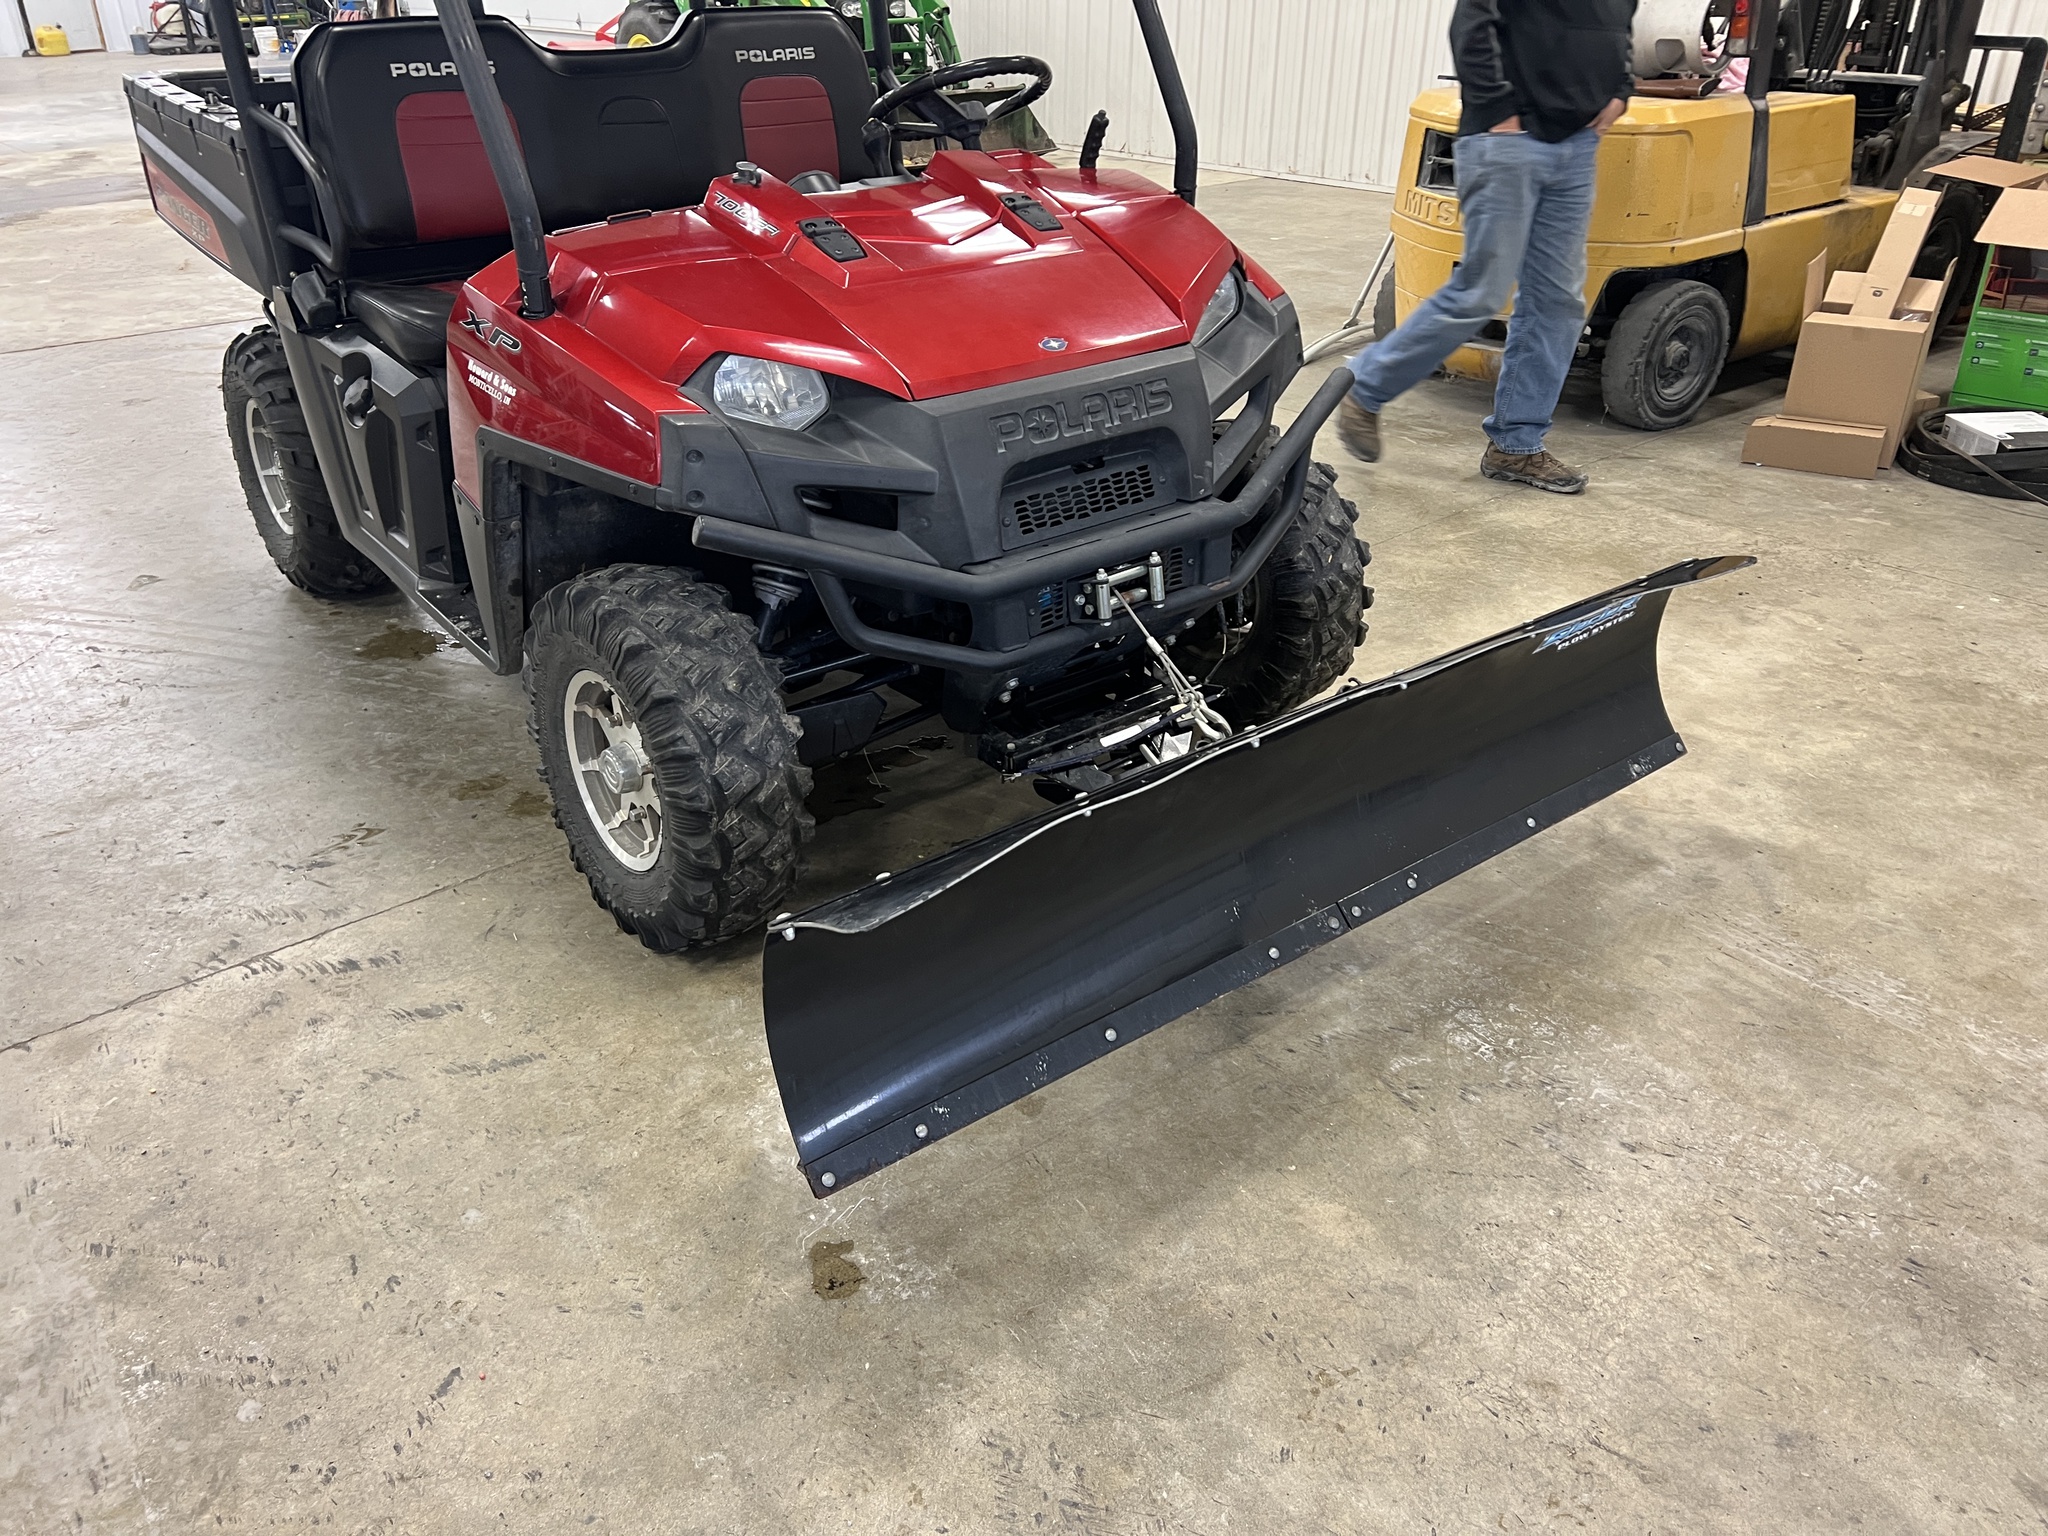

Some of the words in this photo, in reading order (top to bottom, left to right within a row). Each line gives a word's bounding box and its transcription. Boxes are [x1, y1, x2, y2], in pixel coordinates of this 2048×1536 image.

[389, 60, 497, 78] POLAS
[735, 46, 816, 63] POLARIS
[713, 190, 752, 221] 700
[1403, 189, 1463, 226] MITS
[459, 307, 522, 352] XP
[467, 359, 494, 382] Howard
[492, 374, 500, 387] &
[499, 379, 517, 397] Sons
[503, 395, 512, 406] IN
[989, 378, 1173, 454] POLARIS
[1557, 631, 1590, 652] PLOW
[1591, 611, 1633, 634] SYSTEM
